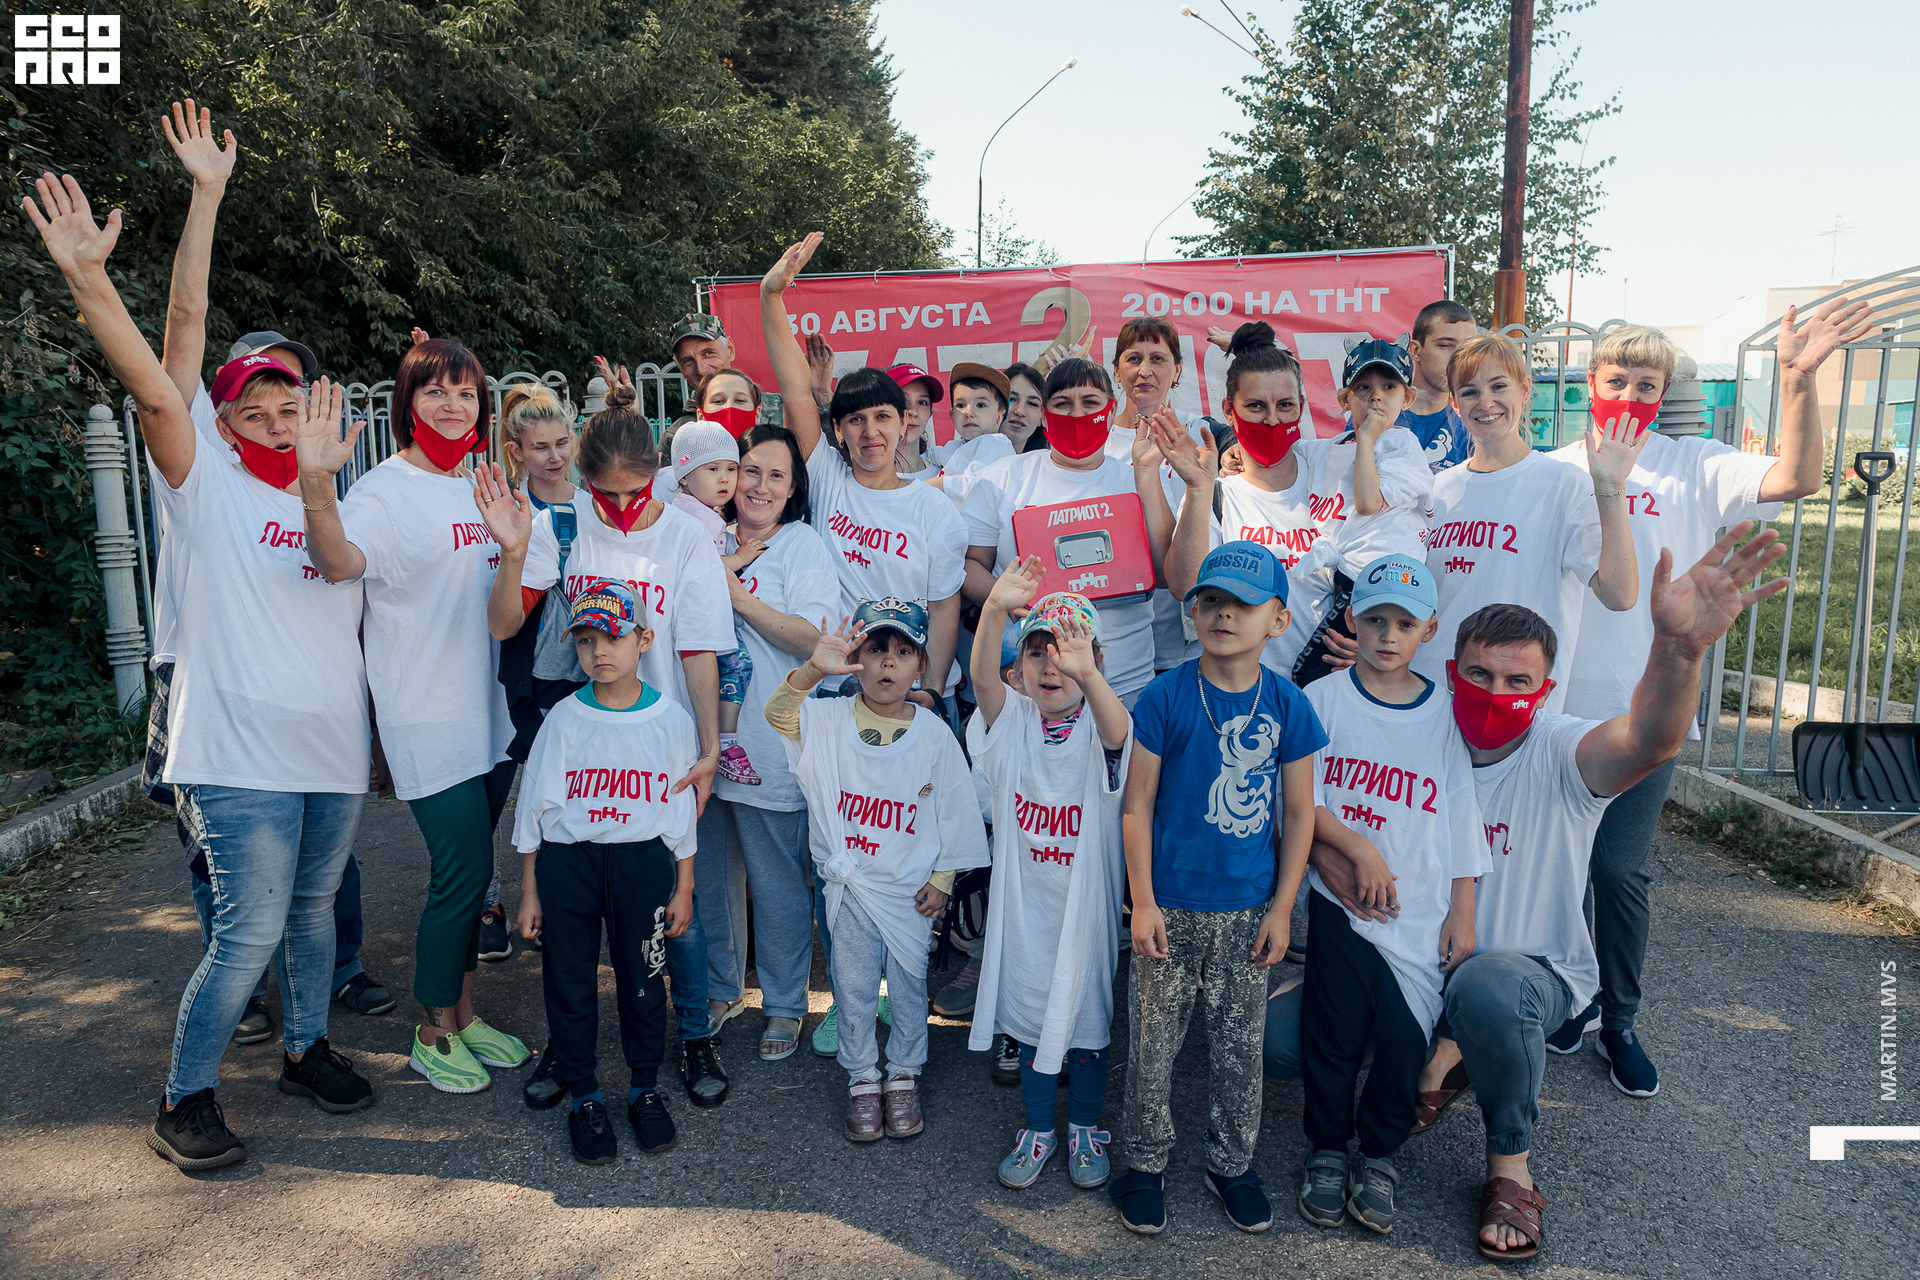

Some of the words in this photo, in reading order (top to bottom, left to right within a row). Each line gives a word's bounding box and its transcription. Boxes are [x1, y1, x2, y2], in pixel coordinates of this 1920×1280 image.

[1121, 292, 1234, 318] 20:00
[1245, 290, 1301, 315] НА
[1310, 287, 1390, 314] ТНТ
[830, 301, 991, 334] АВГУСТА
[1047, 503, 1103, 528] ПАТРИОТ
[1100, 502, 1114, 518] 2
[1641, 491, 1660, 517] 2
[896, 532, 909, 560] 2
[1502, 524, 1518, 554] 2
[1206, 552, 1261, 577] RUSSIA
[1391, 562, 1417, 573] HAPPY
[1444, 556, 1475, 574] ТНТ
[1068, 572, 1109, 593] ТНТ
[654, 584, 666, 616] 2
[565, 768, 653, 803] ПАТРИОТ
[657, 772, 669, 804] 2
[1421, 777, 1438, 815] 2
[587, 806, 631, 824] ТНТ
[905, 804, 918, 836] 2
[1341, 803, 1387, 832] ТНТ
[845, 833, 880, 857] ТНТ
[1029, 846, 1075, 867] ТНТ
